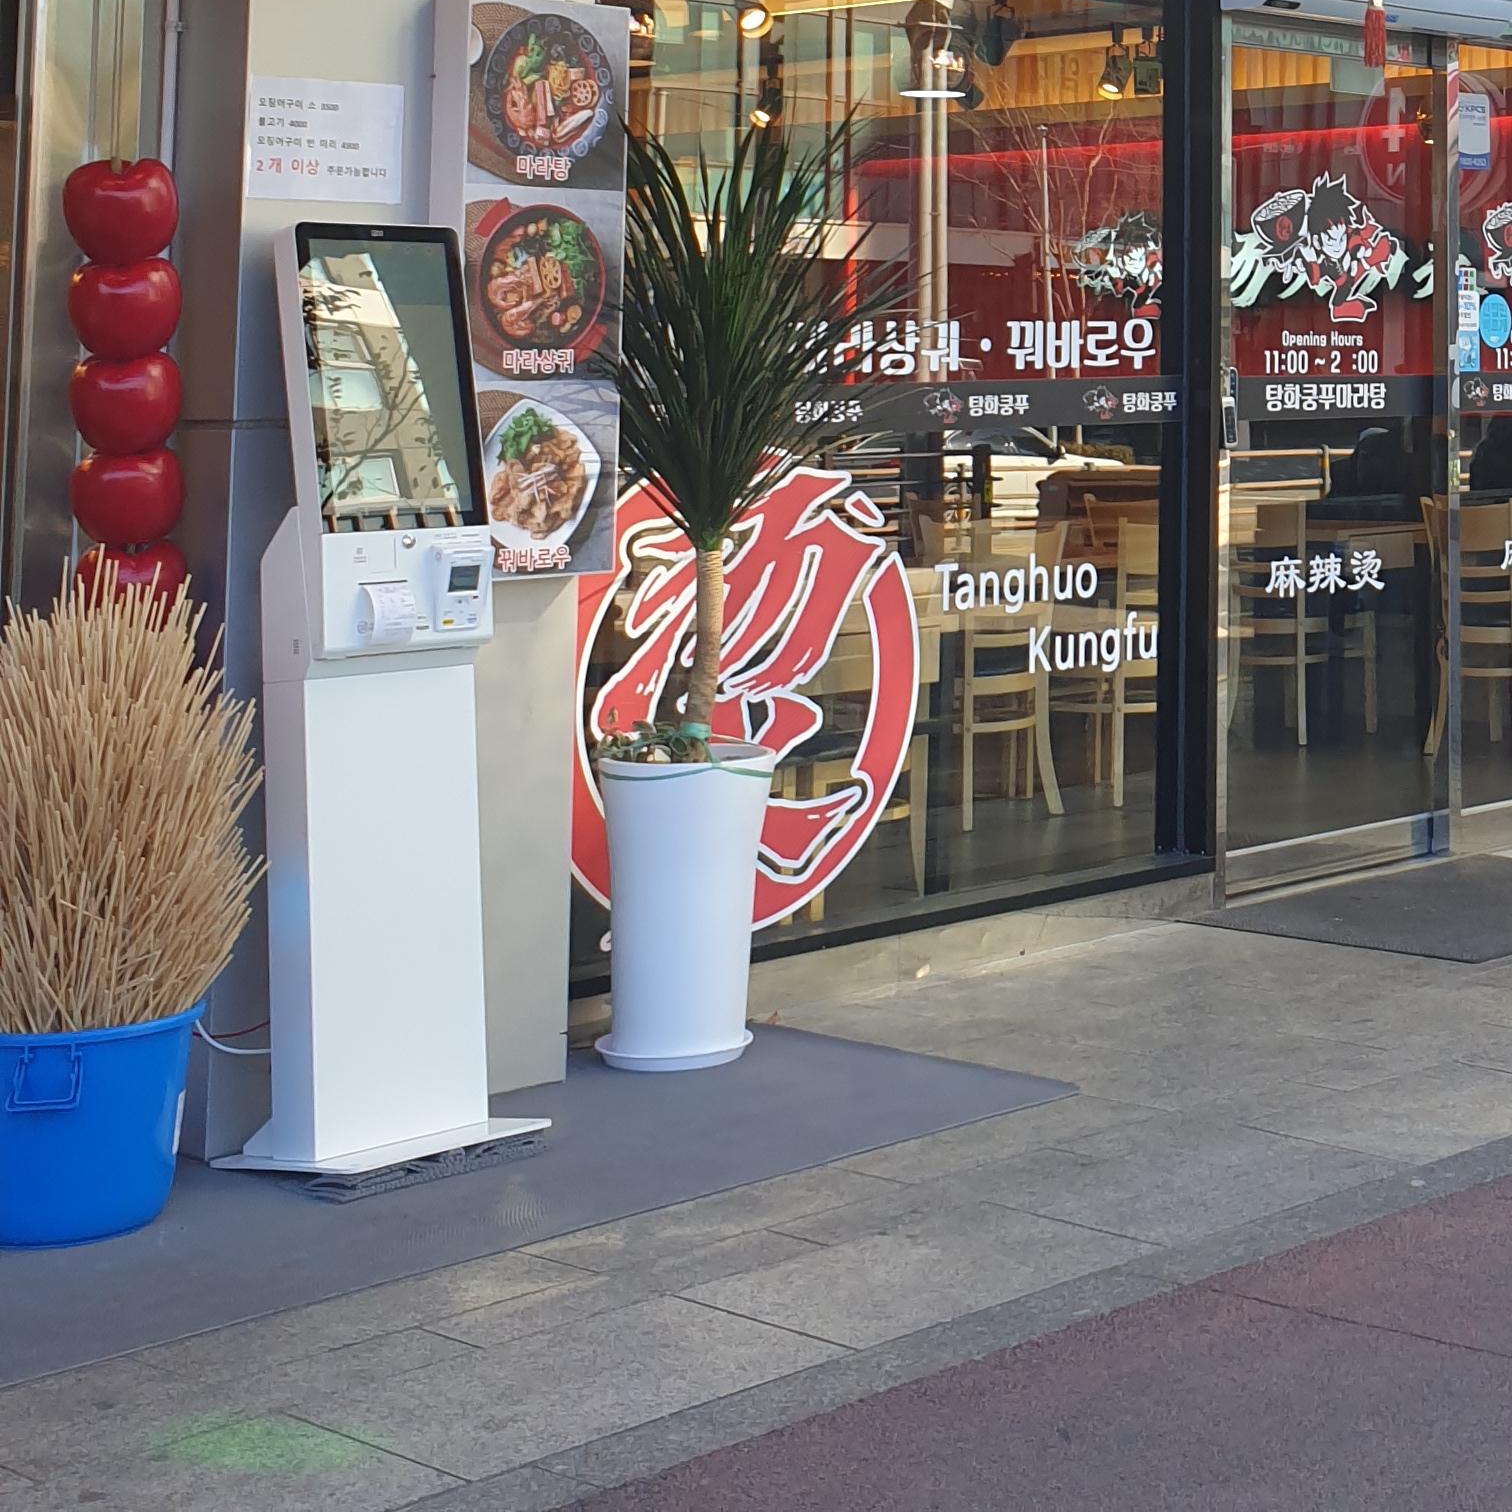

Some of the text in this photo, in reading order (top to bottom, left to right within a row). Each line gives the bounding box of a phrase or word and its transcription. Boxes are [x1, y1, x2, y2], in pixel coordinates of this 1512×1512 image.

[291, 158, 320, 176] 이상
[516, 154, 572, 181] 마라탕
[1006, 318, 1156, 371] 꿔바로우
[1281, 330, 1363, 348] Opening Hours
[502, 348, 575, 374] 마라샹궈
[1264, 350, 1309, 374] 11:00
[968, 394, 1030, 417] 탕화쿵푸
[1122, 390, 1178, 414] 탕화쿵푸
[1265, 382, 1387, 412] 탕화쿵푸마라탕
[498, 544, 572, 572] 꿔바로우
[934, 552, 1098, 614] Tanghuo
[1265, 548, 1386, 598] 麻辣烫
[1027, 613, 1158, 674] Kungfu
